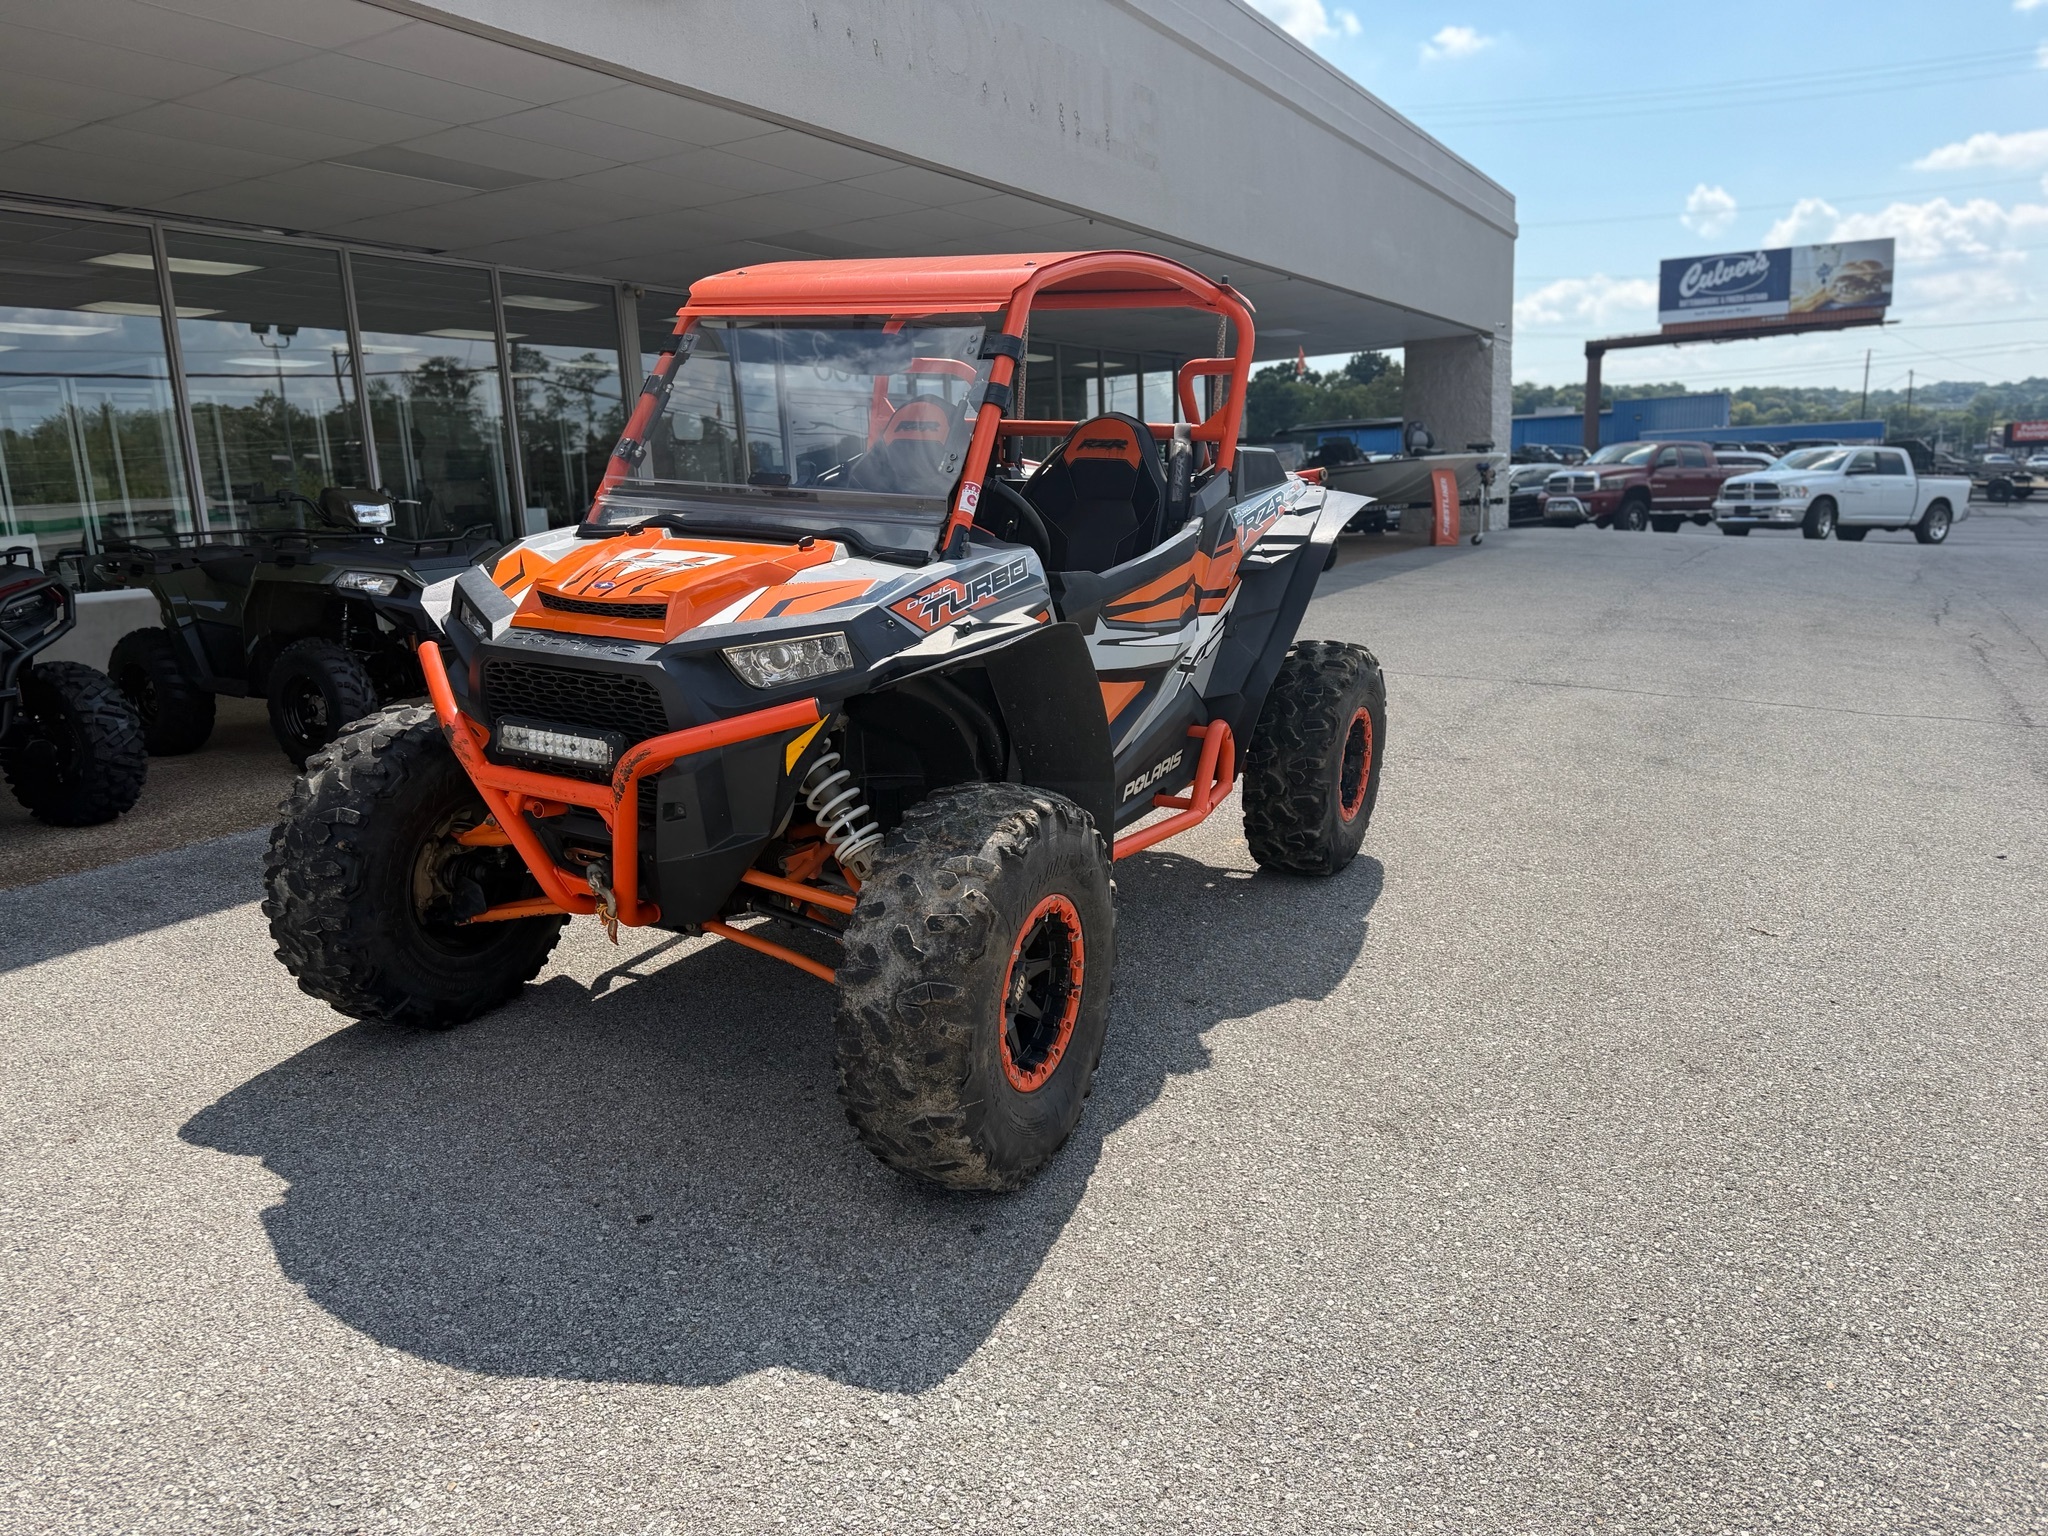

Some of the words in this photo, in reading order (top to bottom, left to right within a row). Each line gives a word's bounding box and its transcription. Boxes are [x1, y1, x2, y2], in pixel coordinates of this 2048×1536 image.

[1679, 251, 1770, 298] Culver's
[1241, 490, 1289, 545] RZR
[1361, 503, 1409, 512] RESTLINER
[1440, 477, 1450, 536] CRESTLINER
[906, 584, 951, 611] DOHC
[919, 555, 1029, 627] TURBO
[1122, 749, 1184, 803] POLARIS
